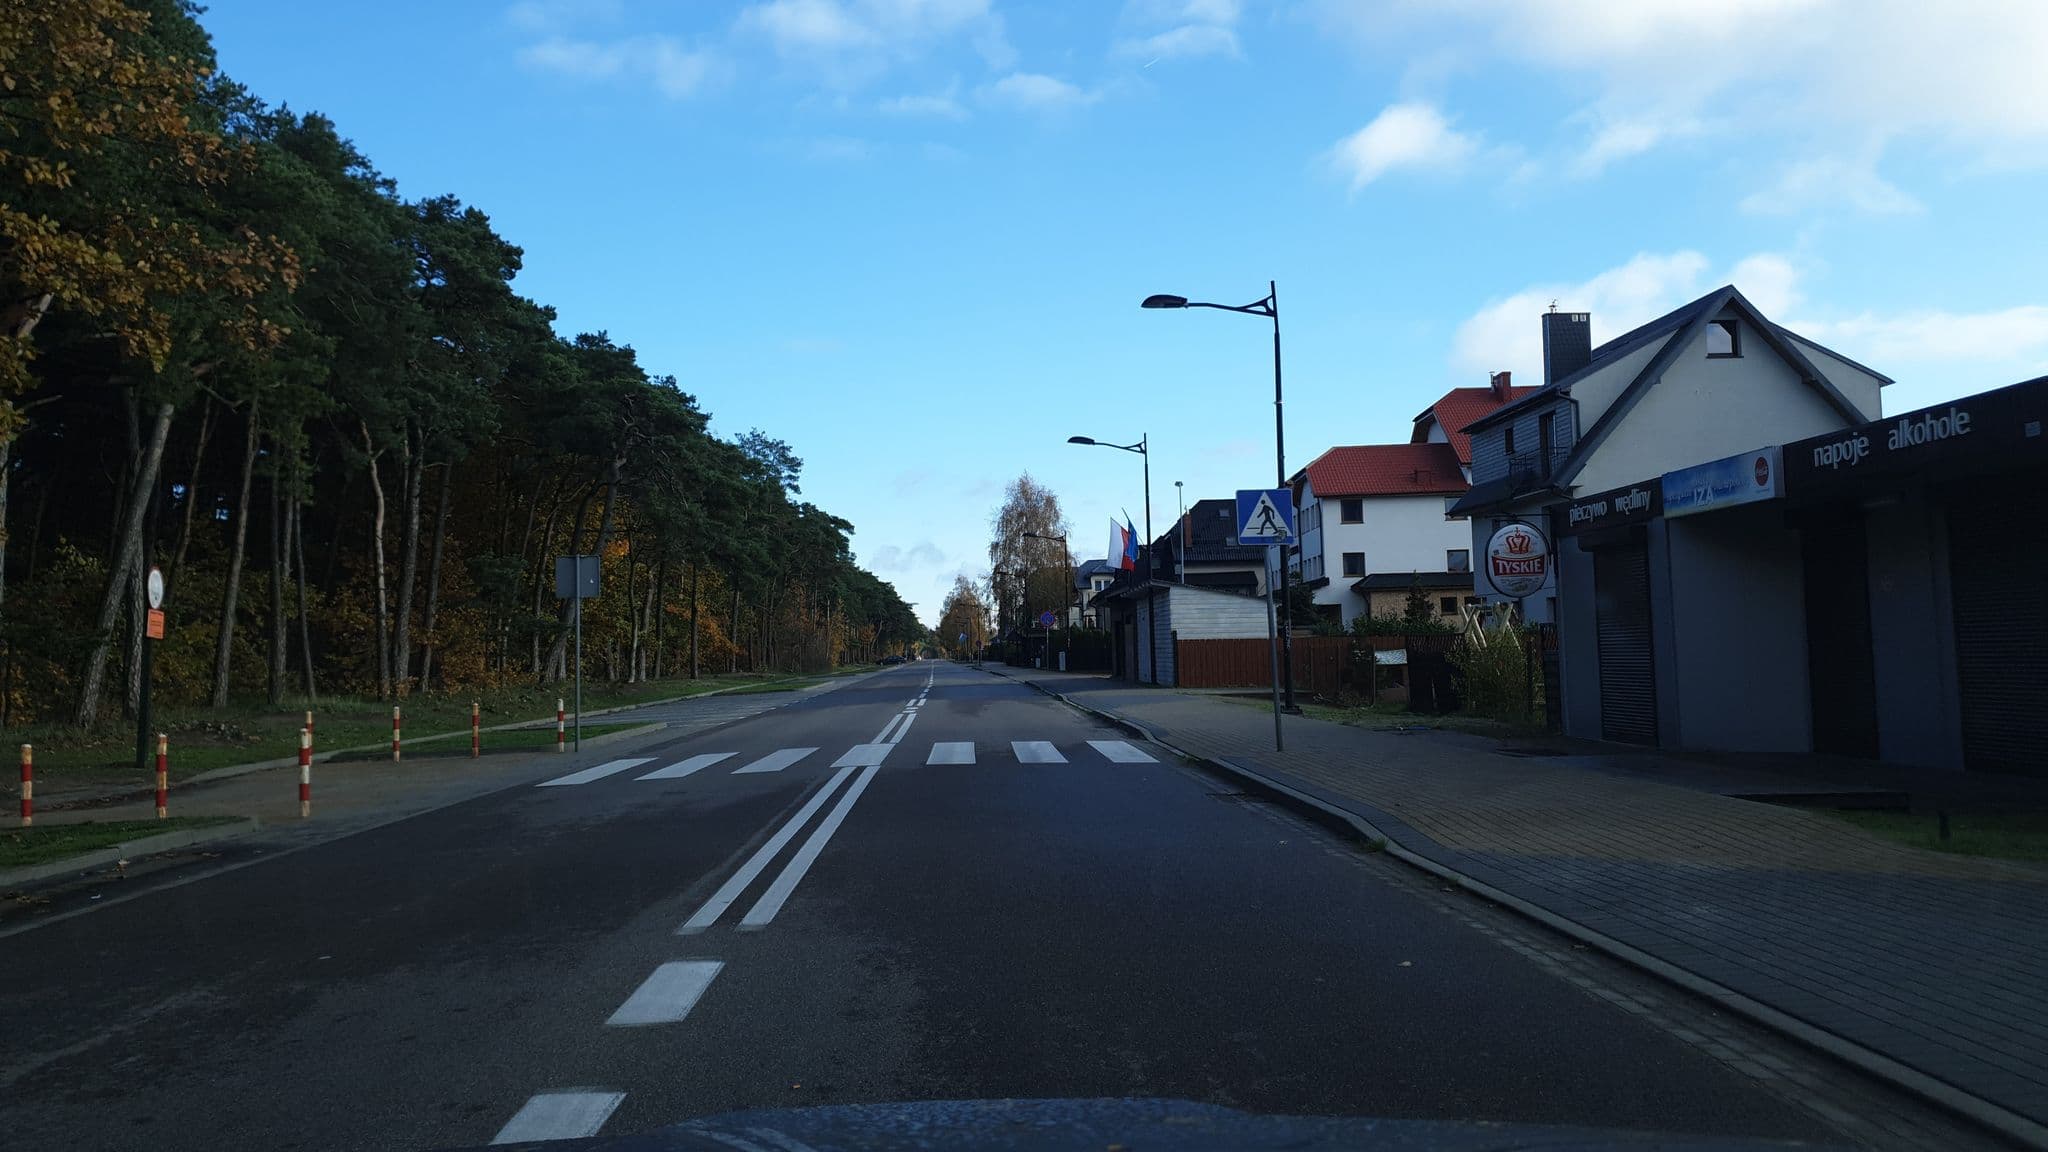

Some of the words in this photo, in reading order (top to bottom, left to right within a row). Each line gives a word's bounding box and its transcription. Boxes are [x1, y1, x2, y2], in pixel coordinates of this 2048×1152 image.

[1813, 432, 1870, 470] napoje
[1887, 407, 1972, 451] alkohole
[1569, 501, 1608, 527] pieczywo
[1615, 488, 1651, 515] wędliny
[1694, 487, 1714, 506] IZA
[1496, 558, 1543, 574] TYSKIE
